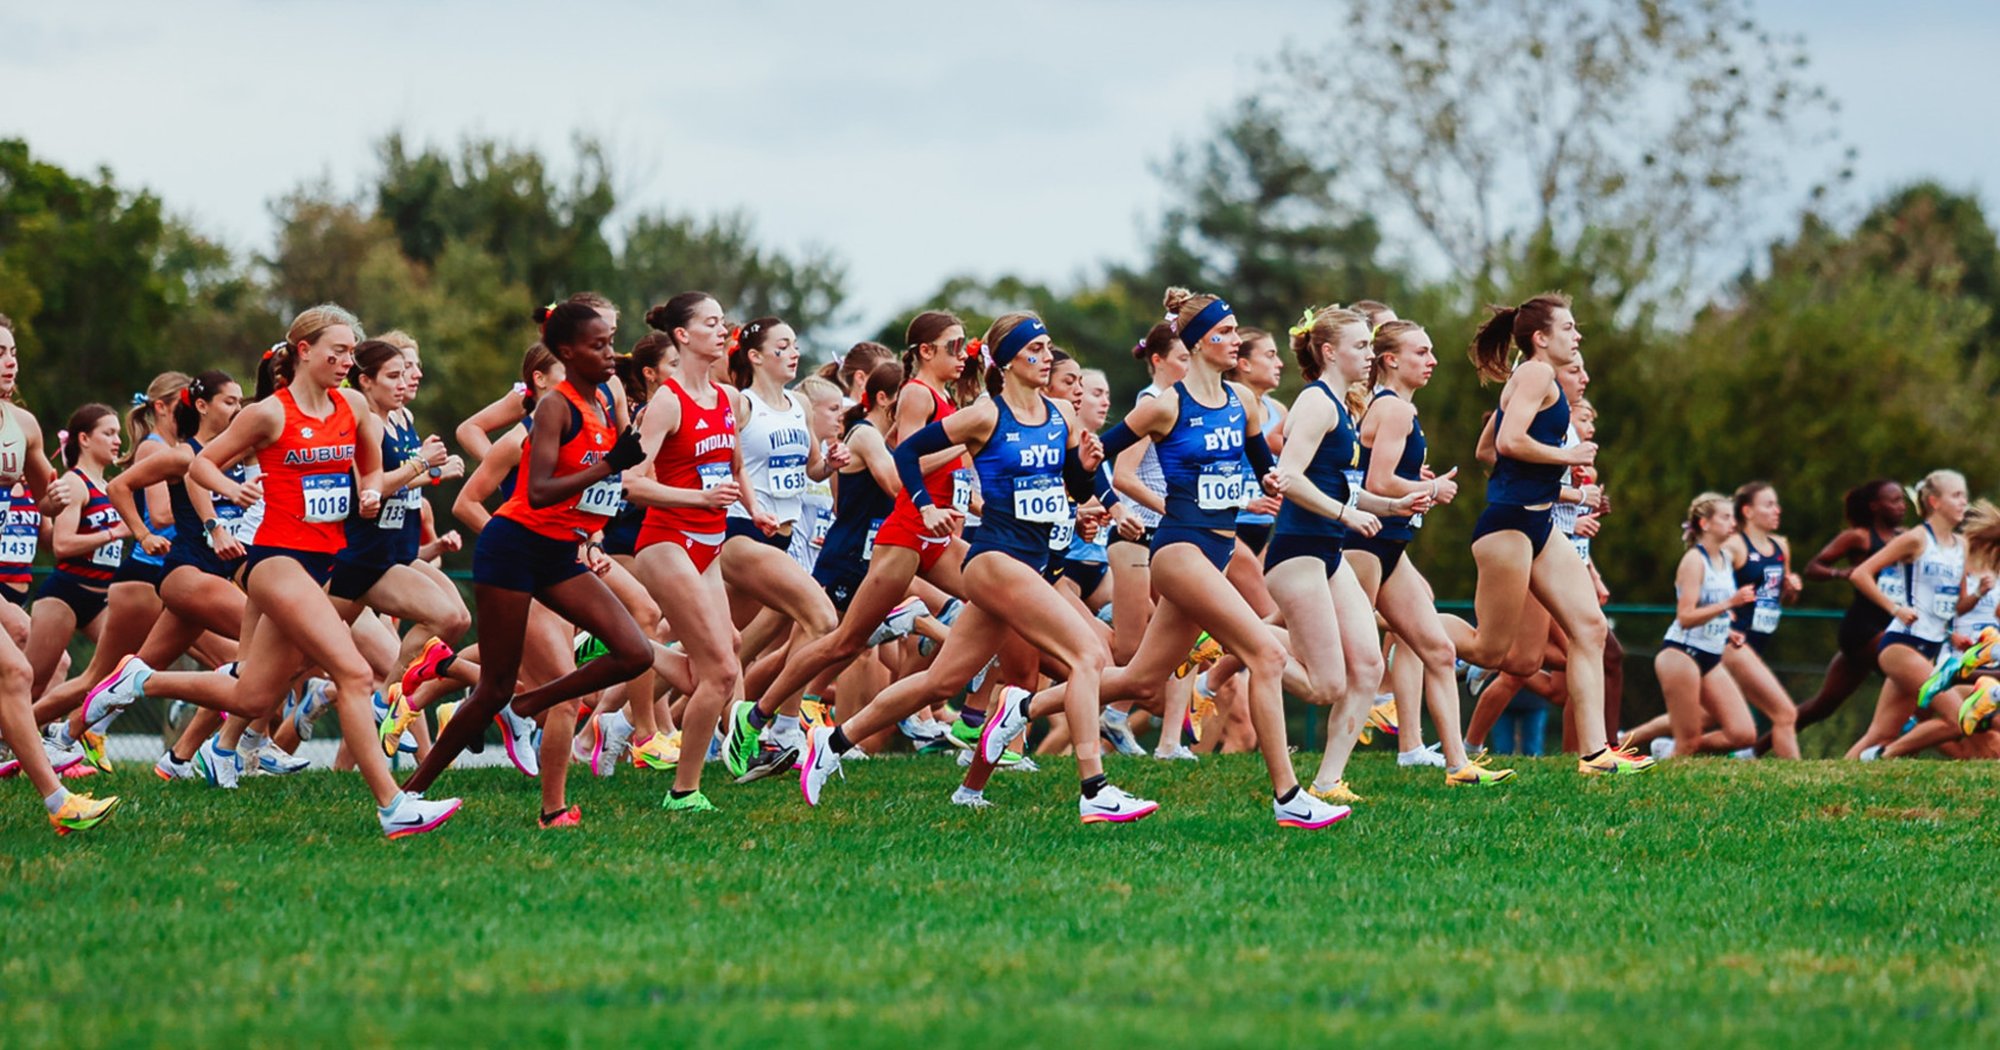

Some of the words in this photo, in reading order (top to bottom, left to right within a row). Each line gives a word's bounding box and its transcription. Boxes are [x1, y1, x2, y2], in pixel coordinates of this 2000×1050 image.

[1204, 427, 1243, 450] BYU
[1020, 445, 1060, 467] BYU
[1202, 483, 1240, 500] 1063
[309, 496, 347, 515] 1018
[1019, 495, 1065, 515] 1067
[1, 542, 34, 555] 1431
